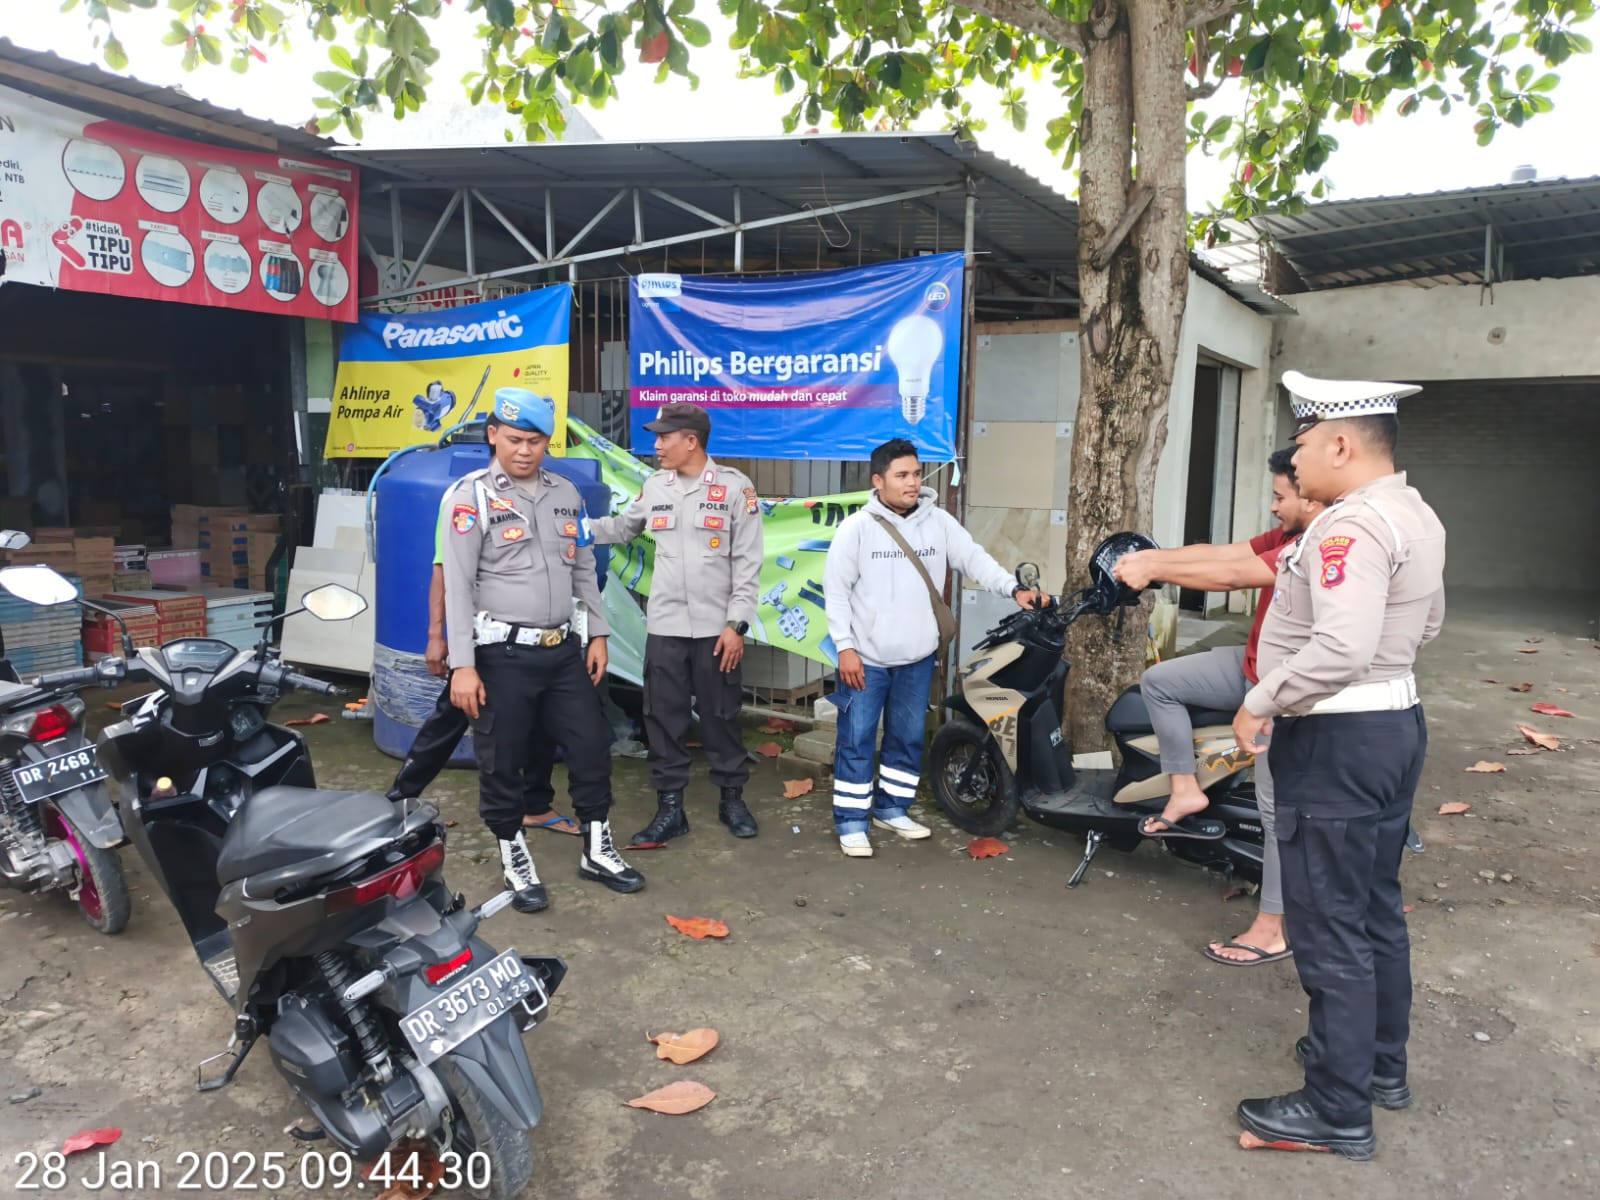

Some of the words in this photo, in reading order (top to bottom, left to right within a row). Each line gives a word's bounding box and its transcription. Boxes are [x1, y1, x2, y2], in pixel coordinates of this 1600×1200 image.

[86, 221, 121, 236] #tidak
[86, 234, 130, 254] TIPU
[88, 252, 131, 271] TIPU
[382, 310, 524, 349] Panasonic
[639, 350, 724, 381] Philips
[730, 345, 883, 381] Bergaransi
[340, 386, 390, 404] Ahlinya
[639, 390, 668, 402] Klaim
[670, 389, 708, 404] garansi
[711, 390, 720, 402] di
[723, 391, 747, 402] toko
[749, 389, 788, 402] mudah
[791, 389, 813, 402] dan
[816, 391, 848, 404] cepat
[337, 405, 381, 422] Pompa
[383, 405, 404, 418] Air
[700, 502, 729, 512] POLRI
[19, 767, 44, 785] DR
[47, 752, 90, 775] 2468
[436, 964, 468, 985] HONDA
[487, 979, 530, 1015] 01.25
[407, 1009, 441, 1043] DR
[438, 976, 490, 1022] 3673
